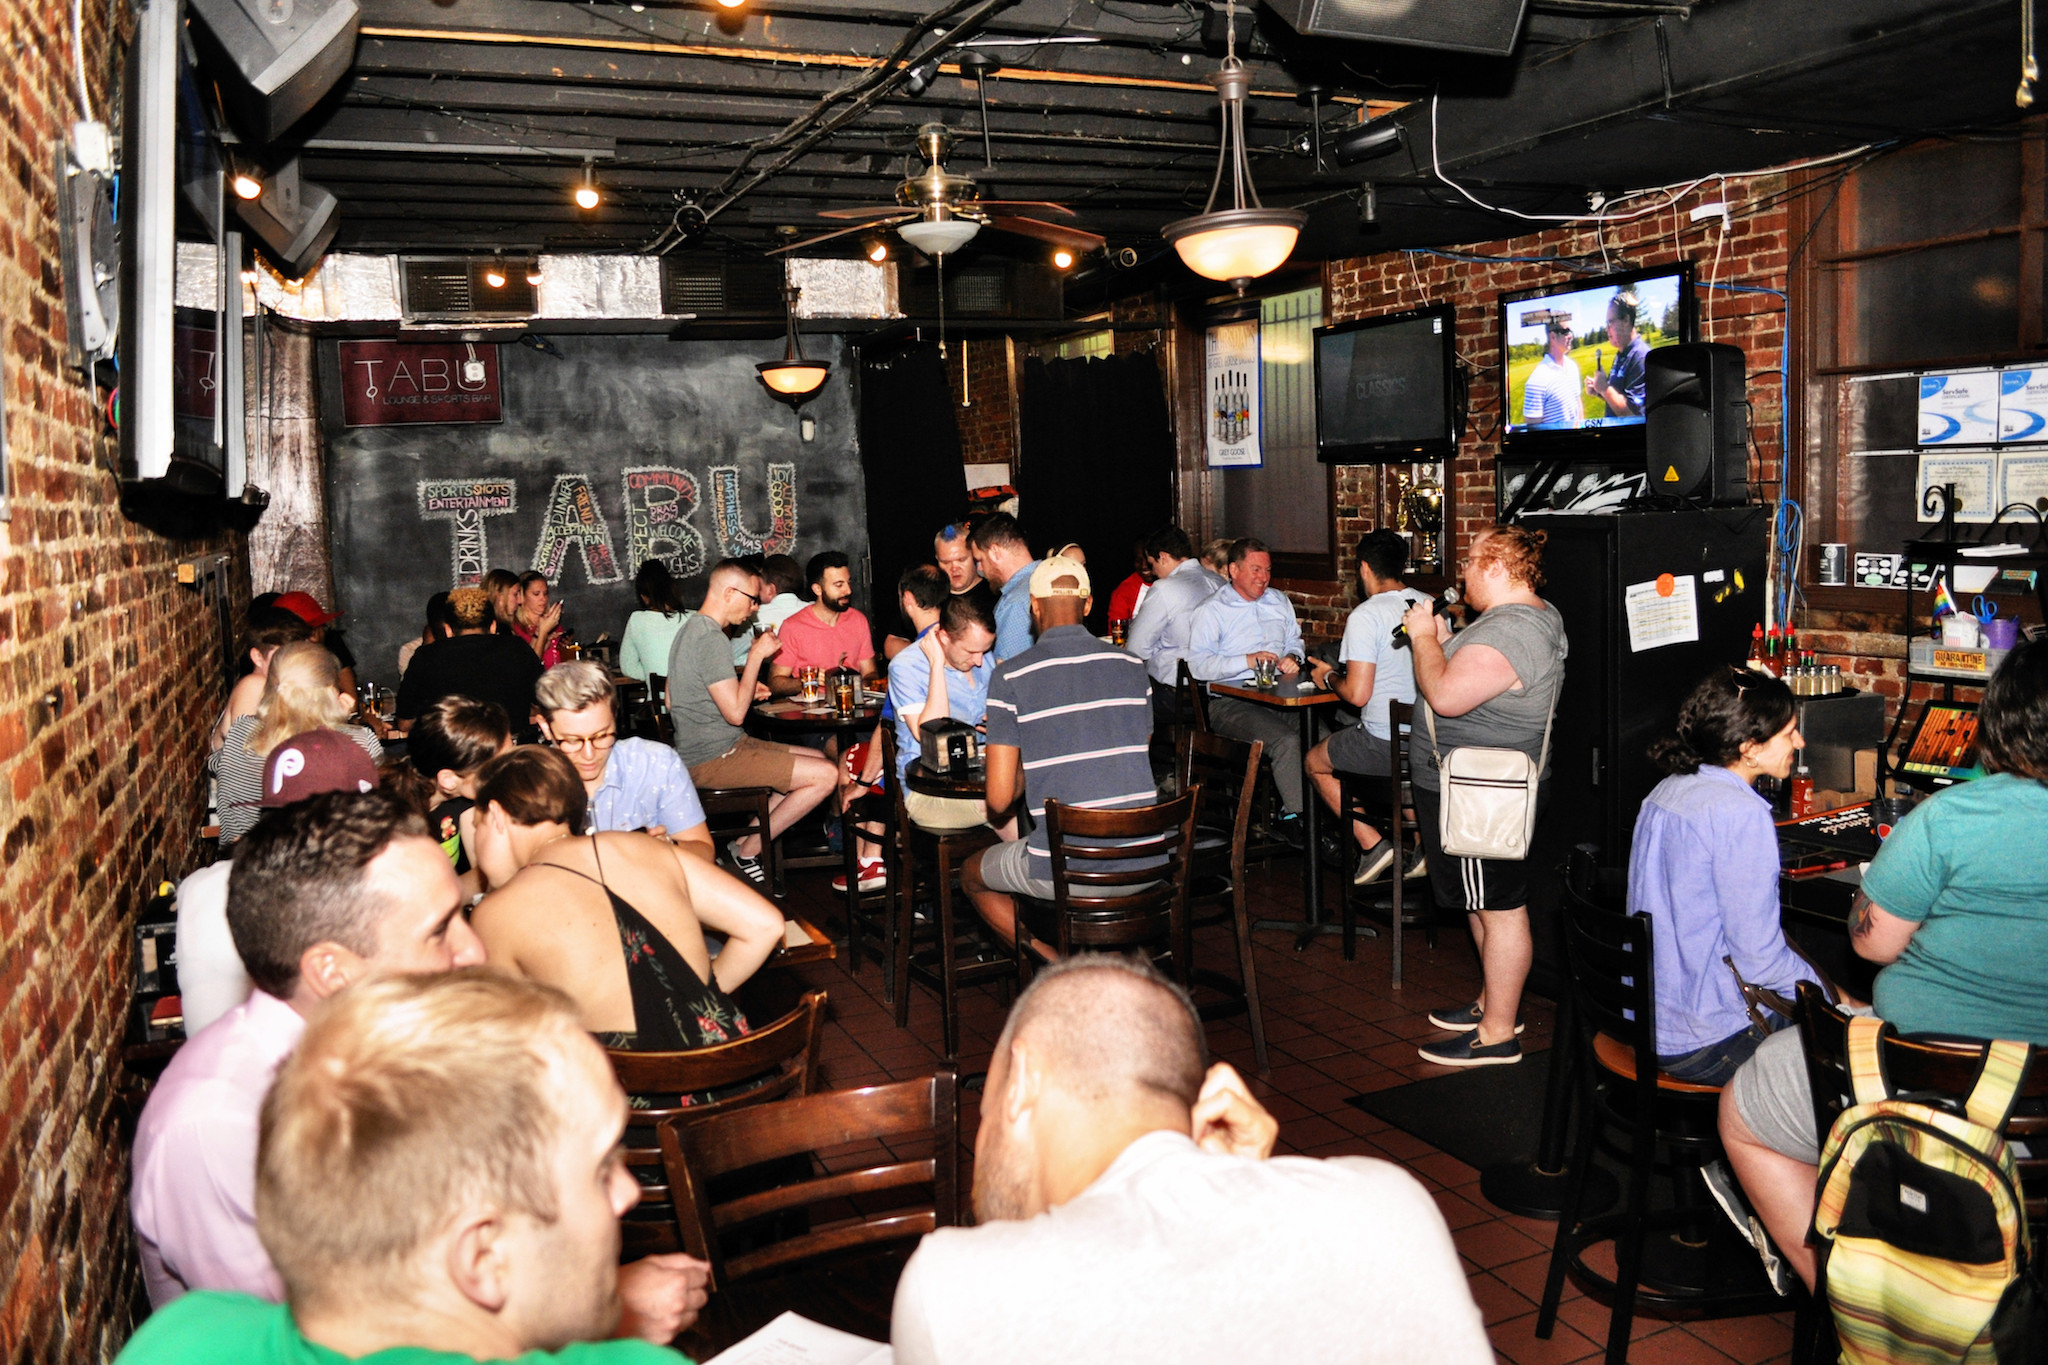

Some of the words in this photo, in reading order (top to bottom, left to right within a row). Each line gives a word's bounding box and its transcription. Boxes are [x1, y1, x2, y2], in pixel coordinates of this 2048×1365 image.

[354, 358, 487, 405] TABU
[382, 396, 420, 405] LOUNGE
[432, 394, 470, 404] SPORTS
[472, 394, 492, 402] BAR
[1230, 447, 1245, 456] GOOSE
[772, 469, 791, 483] JOY
[427, 484, 472, 498] SPORTS
[472, 483, 510, 496] SHOTS
[628, 472, 695, 504] COMMUNITY
[428, 495, 510, 510] ENTERTAINMENT
[573, 485, 594, 525] FRIEND
[650, 501, 678, 516] DRAG
[724, 473, 739, 536] HAPPINESS
[782, 481, 794, 539] EQUALITY
[650, 513, 677, 525] SHOW
[547, 523, 609, 536] ACCEPTANCE
[649, 524, 697, 553] WELCOME
[762, 517, 784, 551] PRIDE
[456, 509, 481, 574] DRINKS
[584, 534, 606, 545] FUN
[735, 532, 762, 550] DIVAS
[544, 538, 566, 577] QUIZZO
[662, 553, 700, 574] UGHS
[1935, 651, 1982, 665] QUARANTINE
[273, 748, 305, 795] P
